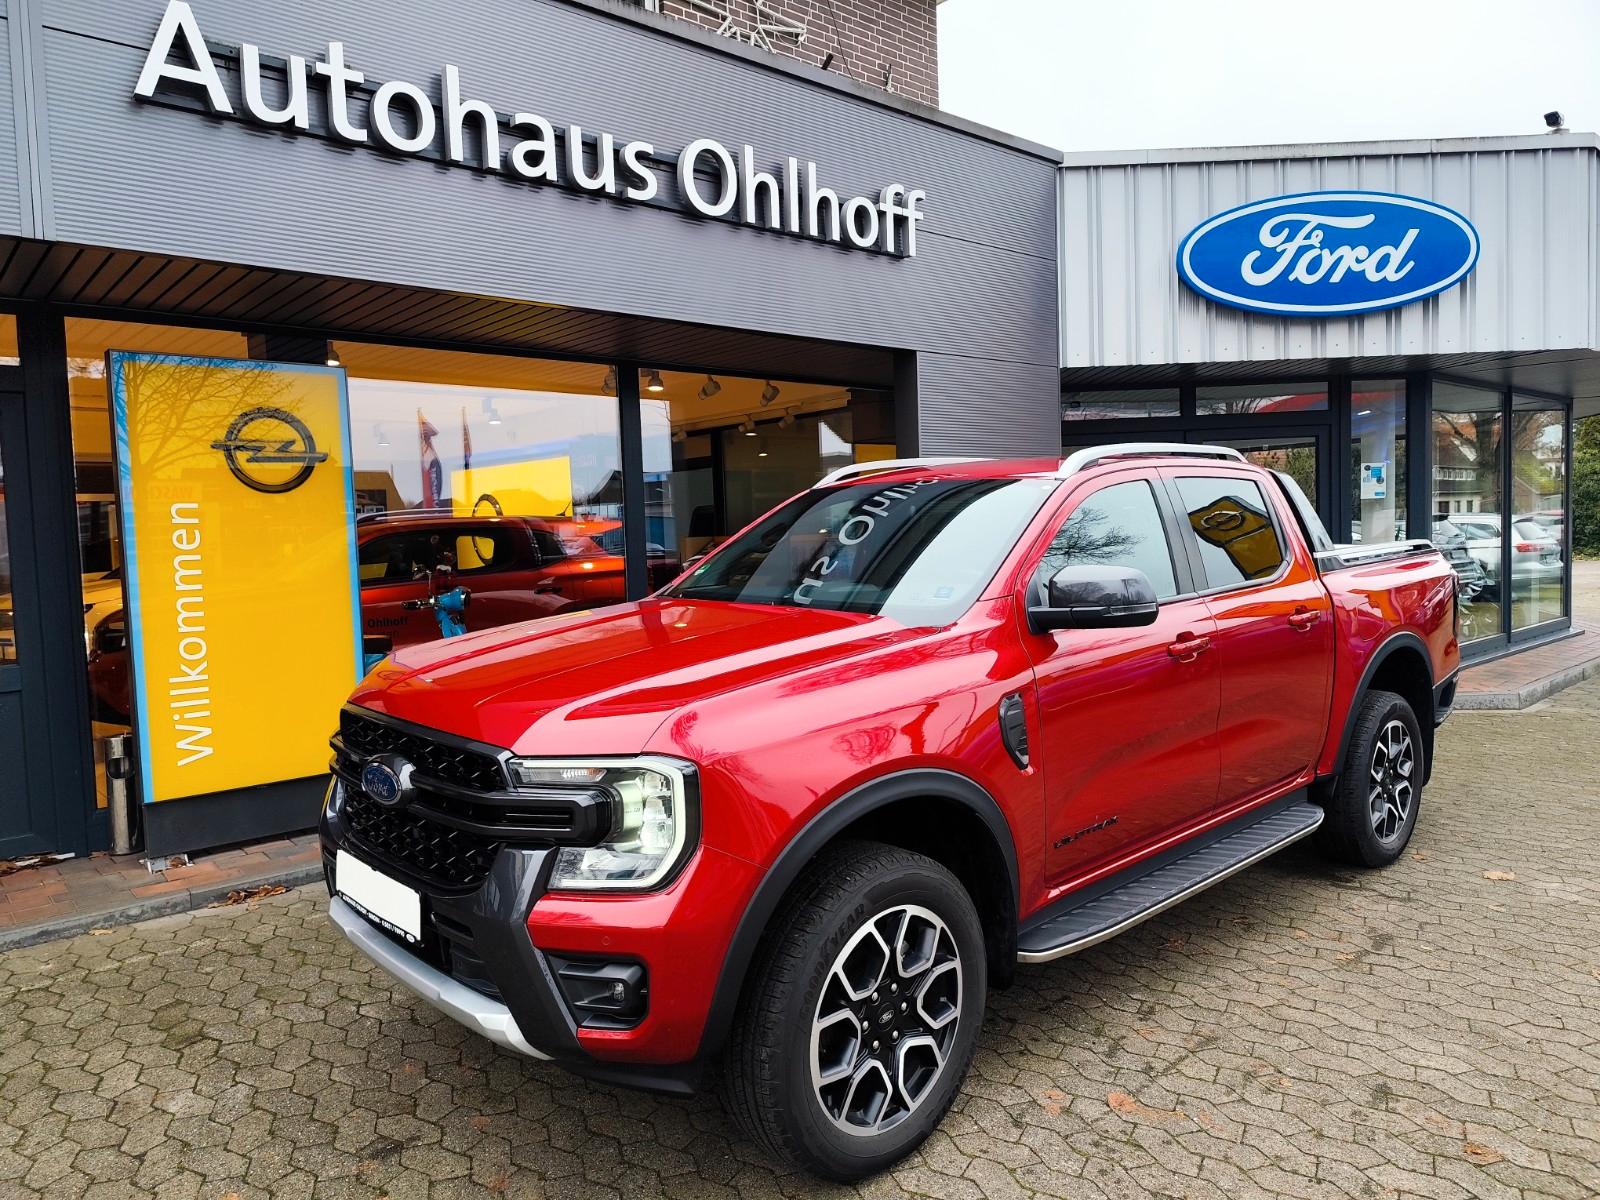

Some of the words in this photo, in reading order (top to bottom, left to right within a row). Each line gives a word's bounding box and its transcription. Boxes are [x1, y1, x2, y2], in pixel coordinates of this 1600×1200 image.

[134, 0, 658, 201] Autohaus
[677, 138, 926, 257] Ohlhoff
[1241, 213, 1420, 287] Ford
[168, 501, 214, 767] Willkommen
